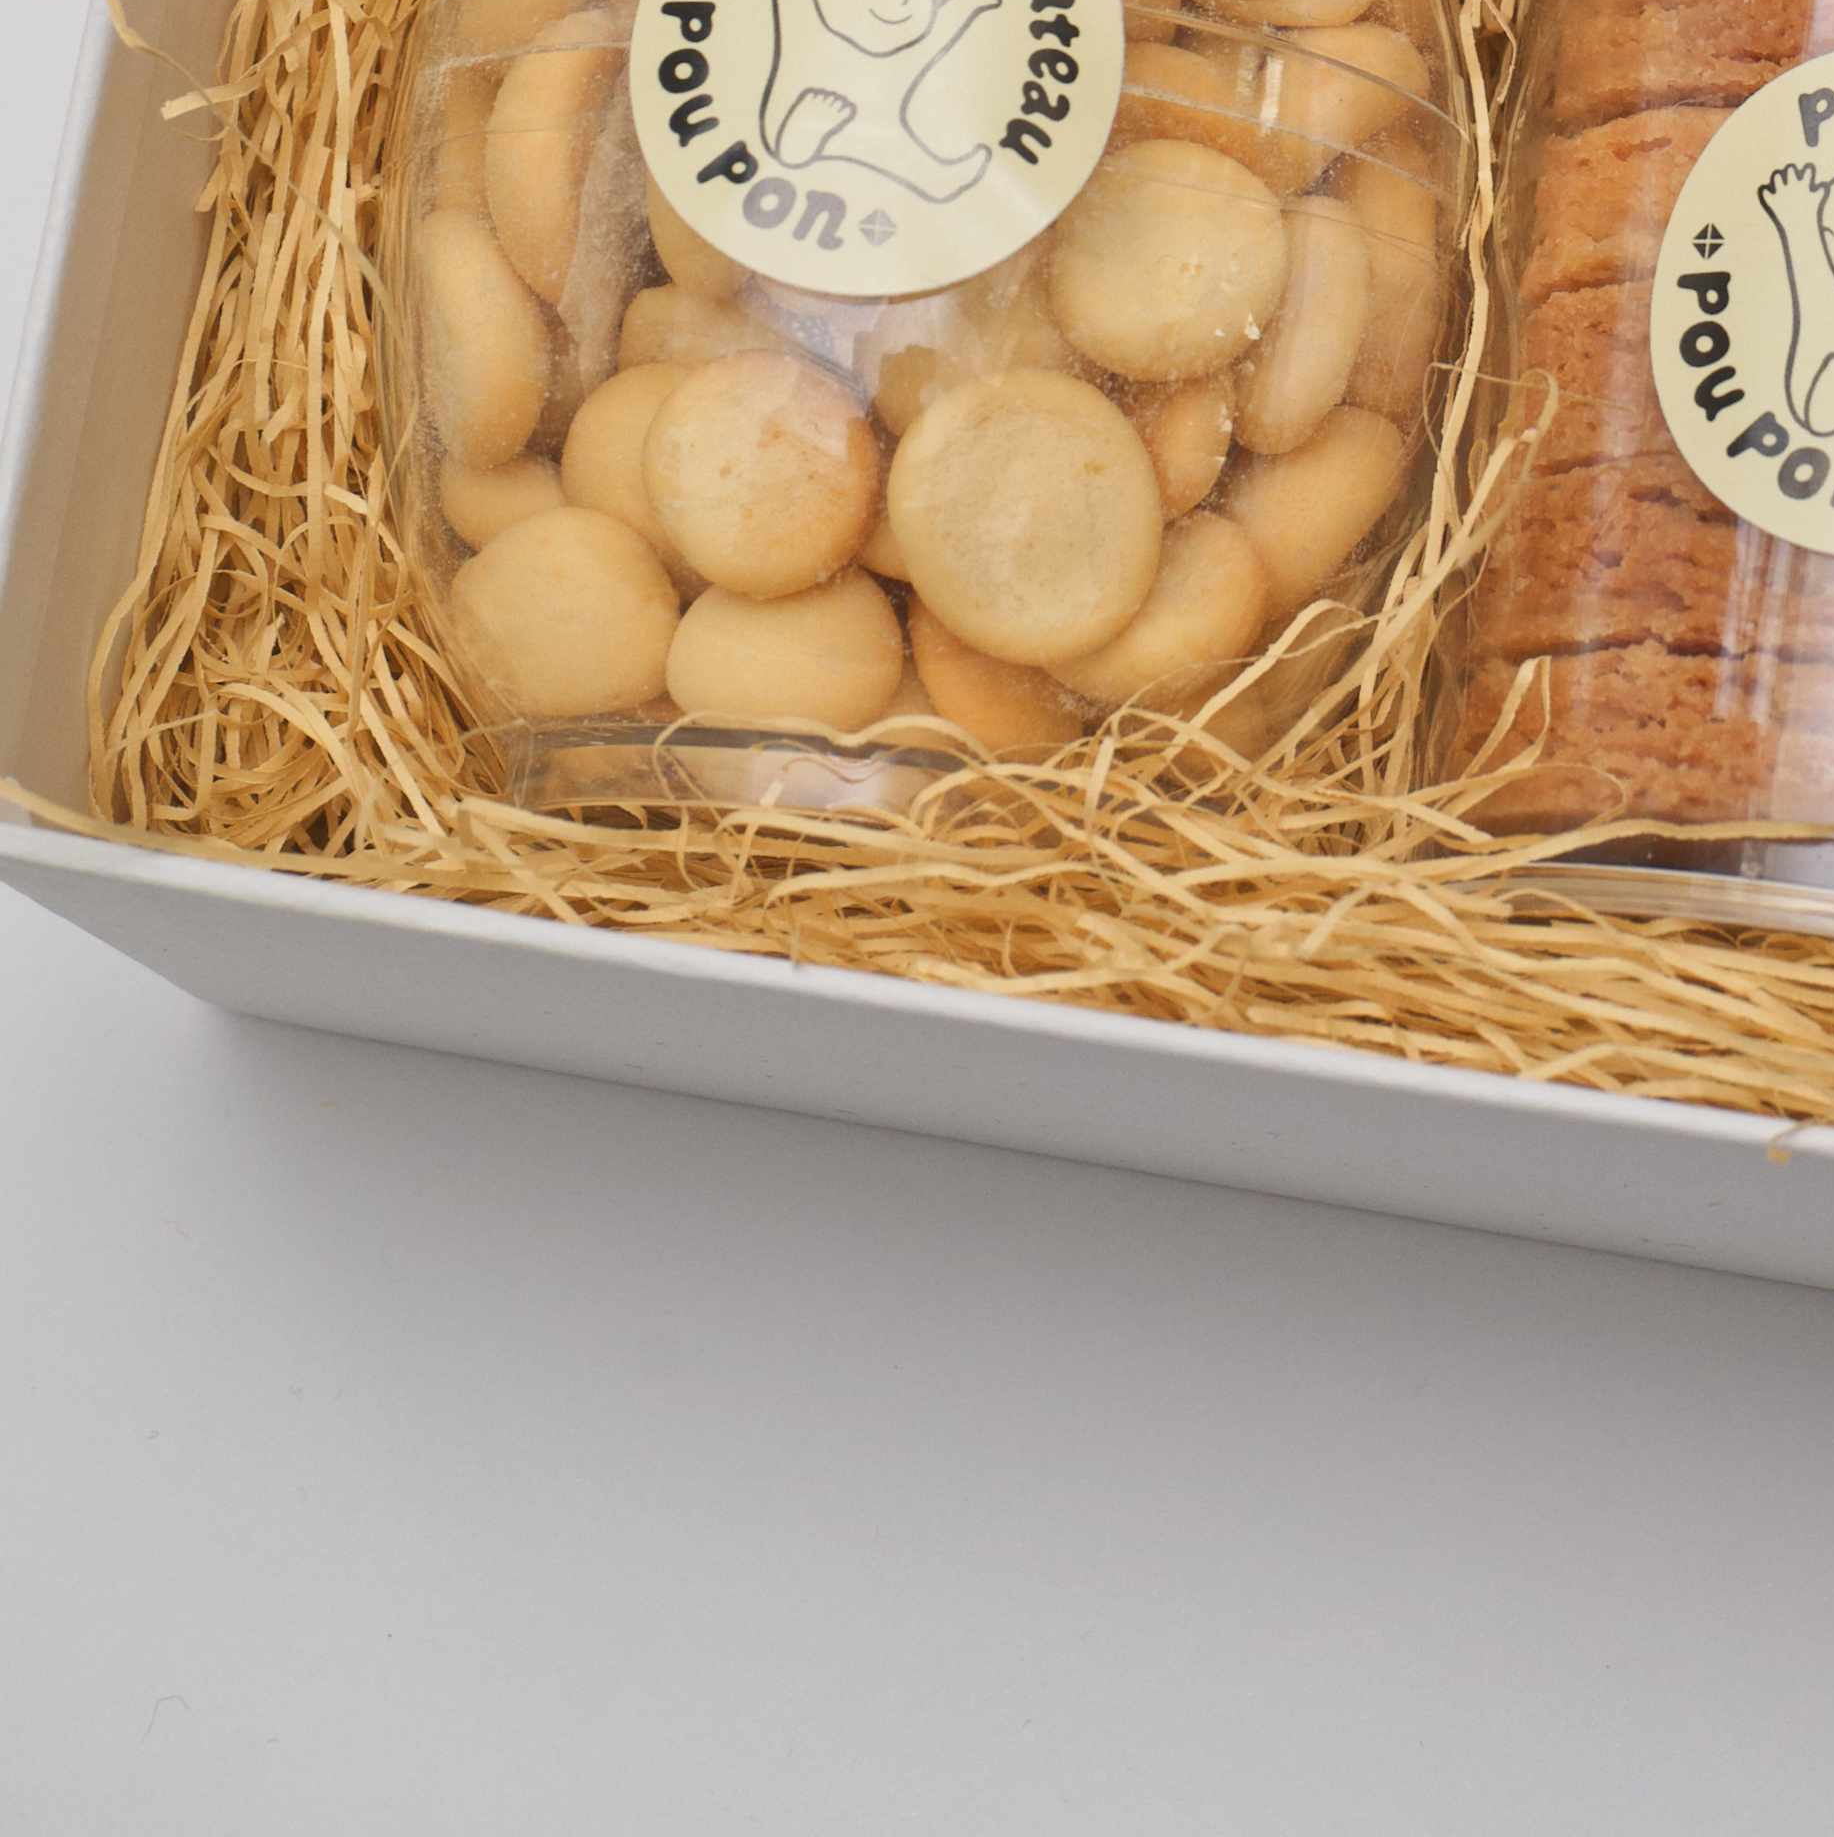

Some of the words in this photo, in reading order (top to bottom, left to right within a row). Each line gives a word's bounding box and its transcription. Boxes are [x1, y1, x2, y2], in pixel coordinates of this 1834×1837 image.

[658, 1, 719, 147] pou
[696, 140, 847, 251] pon
[1676, 271, 1745, 422] pou
